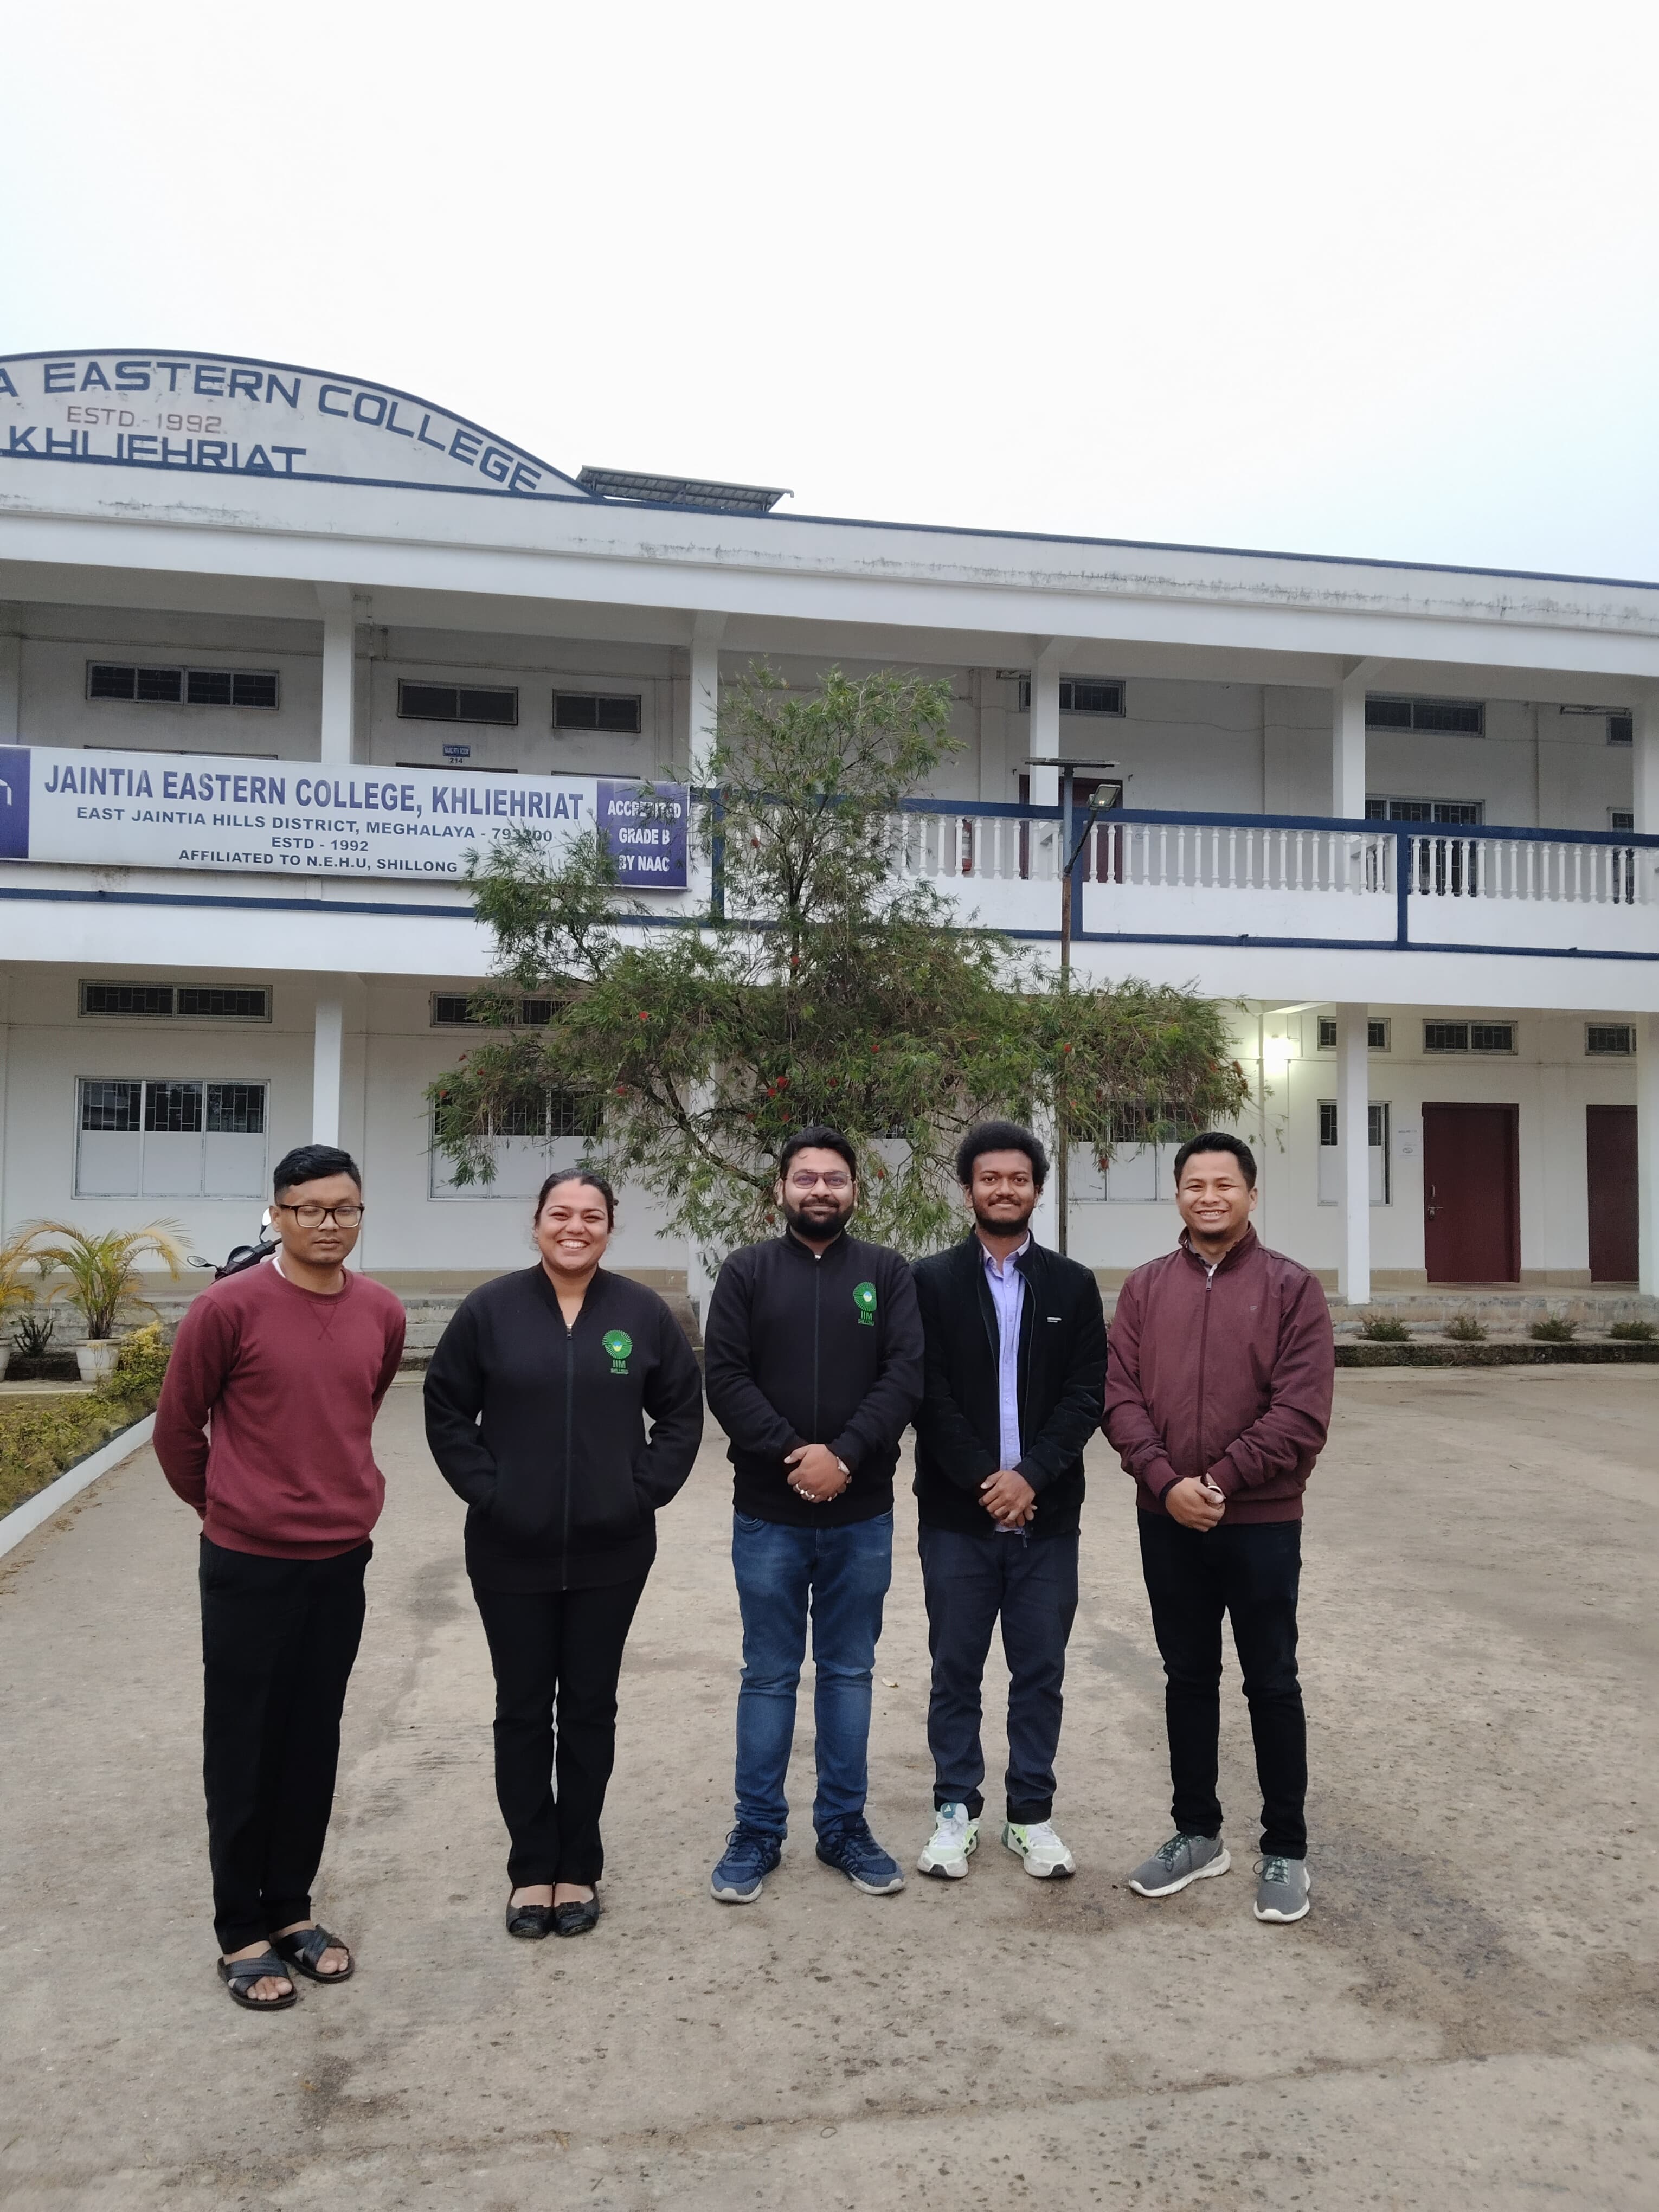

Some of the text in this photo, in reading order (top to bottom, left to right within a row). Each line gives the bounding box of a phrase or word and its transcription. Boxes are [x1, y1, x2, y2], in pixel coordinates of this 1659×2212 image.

[44, 361, 301, 408] EASTERN
[318, 384, 542, 491] COLLEGE
[10, 426, 307, 474] KHLIEHRIAT
[44, 764, 583, 820] JAINTIA EASTERN COLLEGE, KHLIEHRIAT
[607, 800, 681, 818] ACCREITD
[77, 807, 125, 820] EAST
[132, 810, 206, 825] JAINTIA
[213, 814, 265, 828] HILLS
[272, 817, 359, 835] DISTRICT,
[366, 821, 475, 838] MEGHALAYA
[272, 837, 314, 848] ESTD
[331, 840, 369, 851] 1992
[619, 828, 670, 845] GRADE B
[179, 850, 458, 872] AFFILIATED TO N.E.H.U, SHILLONG
[619, 854, 670, 872] BY NAAC
